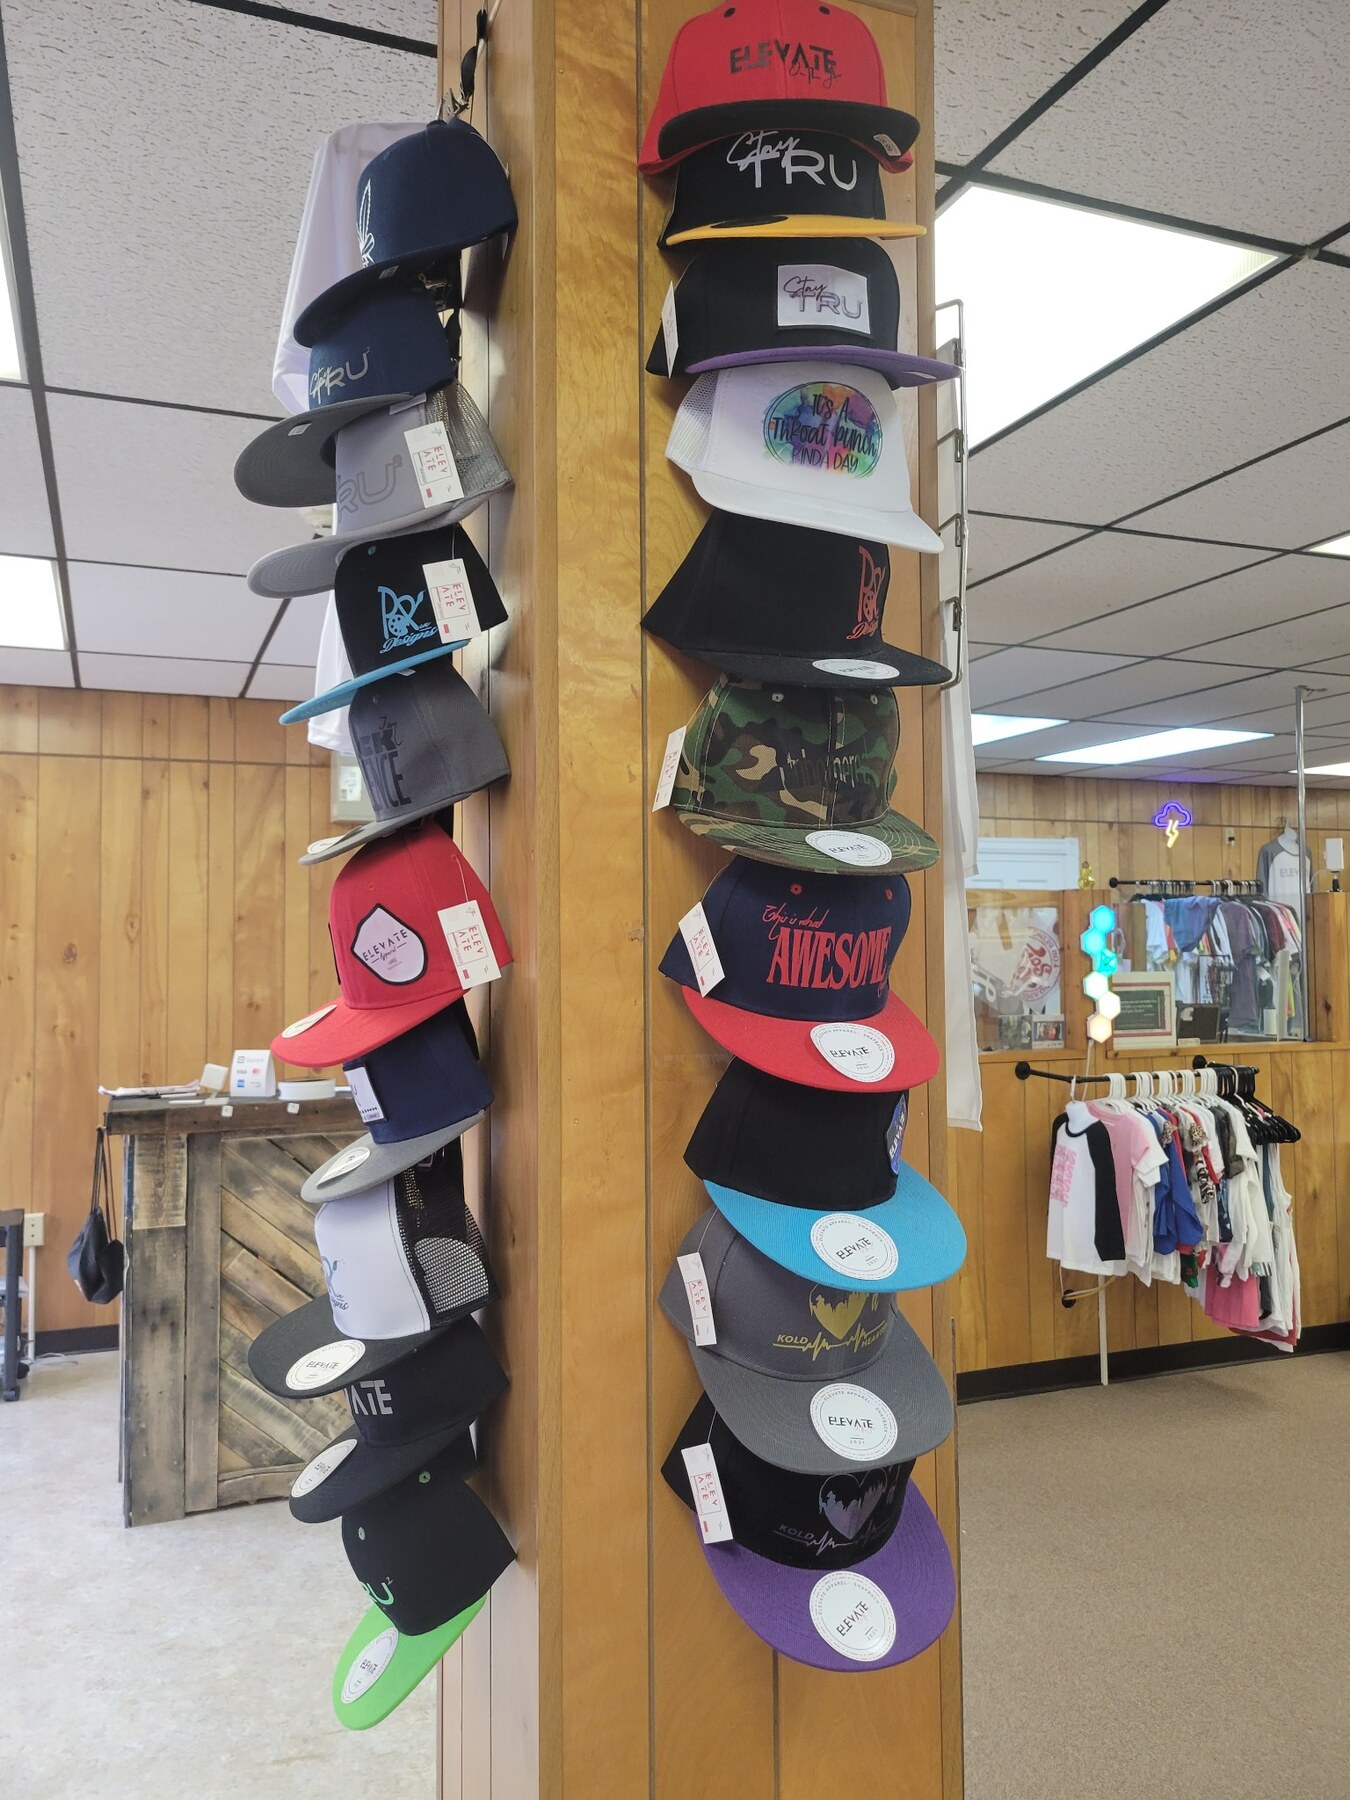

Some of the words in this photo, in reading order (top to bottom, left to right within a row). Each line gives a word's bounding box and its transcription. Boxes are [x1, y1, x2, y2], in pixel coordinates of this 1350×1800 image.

[729, 38, 837, 75] ELEVATE
[737, 149, 858, 191] TRU
[783, 275, 828, 300] Stay
[789, 291, 863, 319] TRU
[838, 396, 851, 423] A
[362, 928, 408, 962] ELEVATE
[765, 925, 893, 990] AWESOME
[829, 1045, 870, 1058] ELEVATE
[835, 1236, 873, 1261] ELEVATE
[777, 1334, 809, 1344] KOLD
[305, 1360, 341, 1370] ELEVATE
[345, 1379, 394, 1416] ATE
[828, 1416, 874, 1429] ELEVATE
[778, 1524, 815, 1540] KOLD
[836, 1600, 869, 1637] ELEVATE
